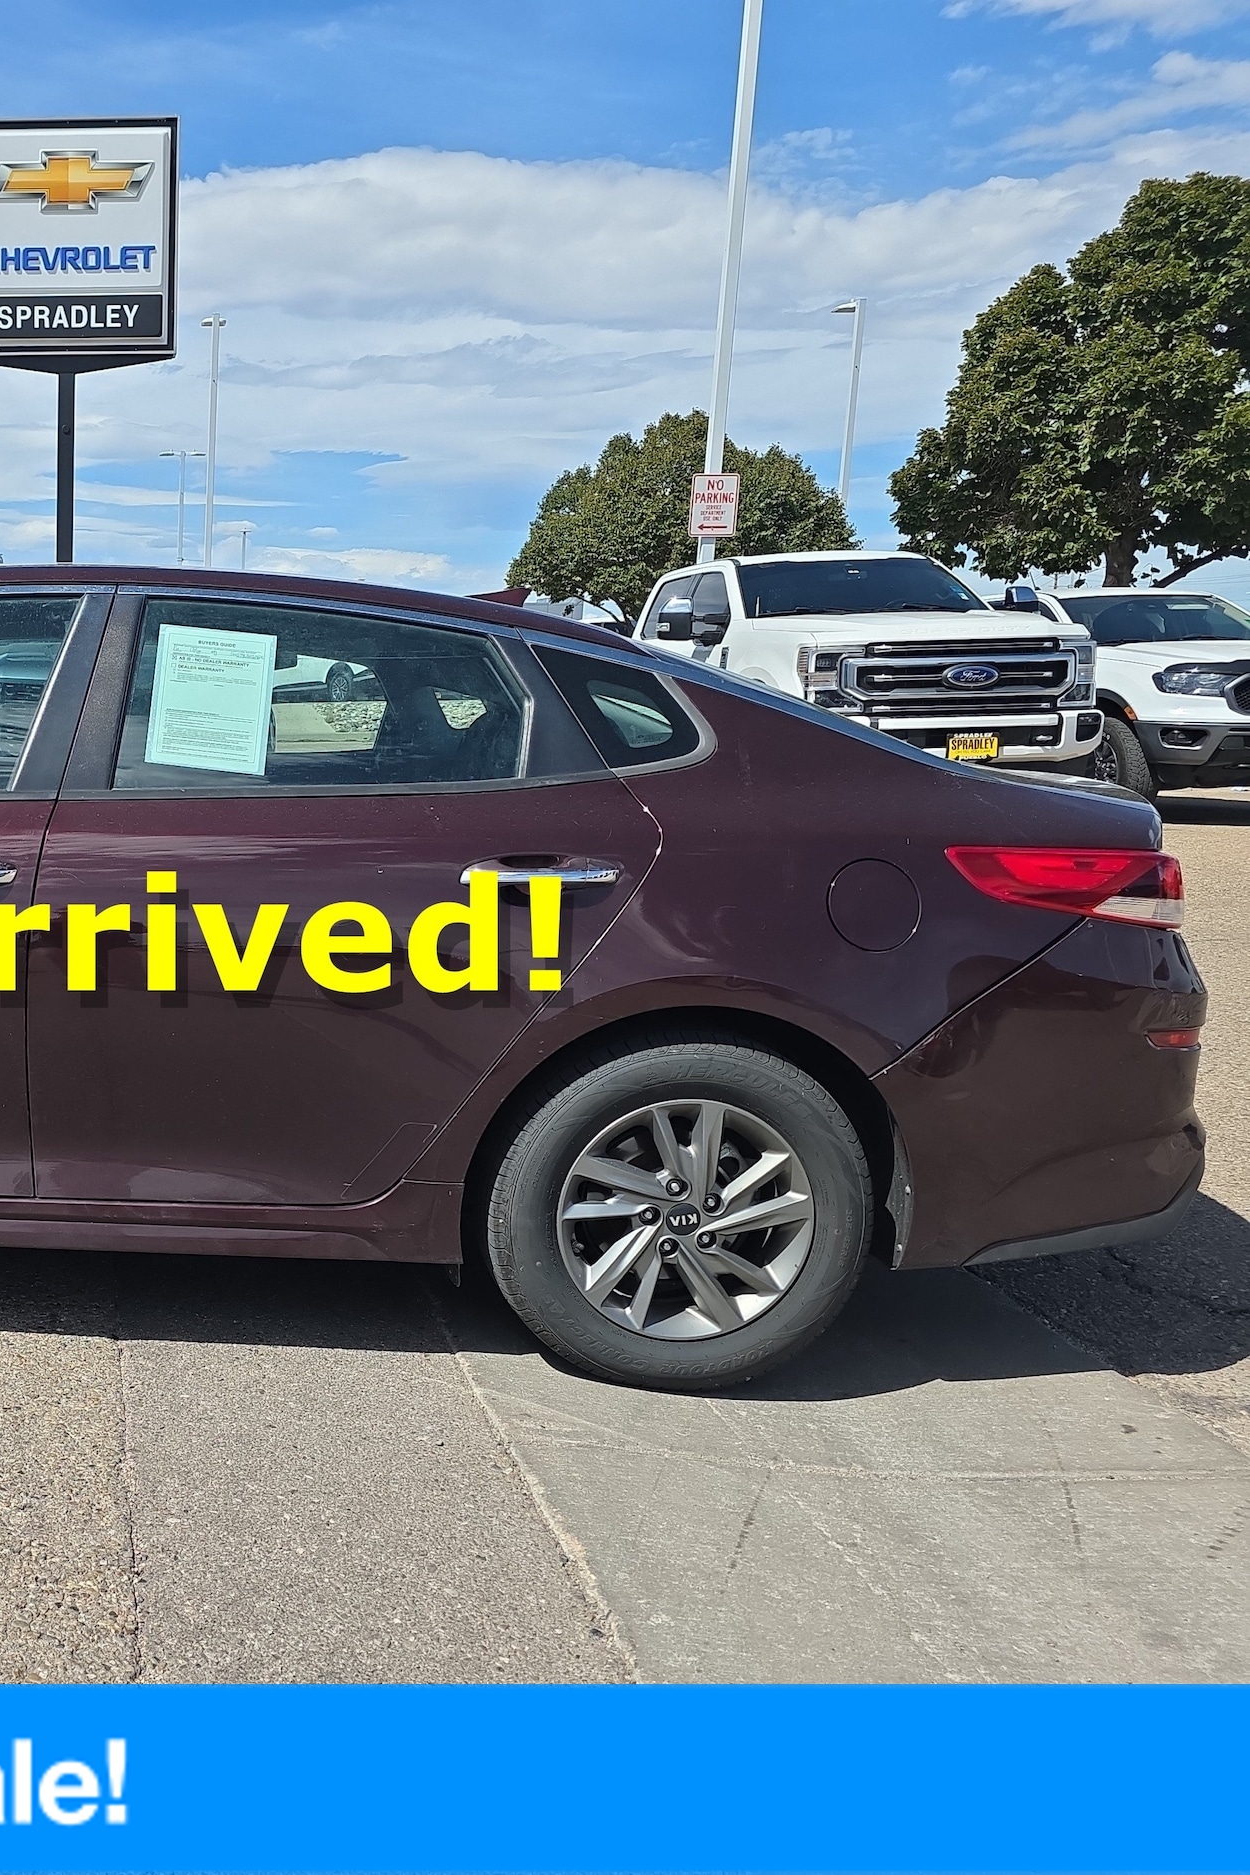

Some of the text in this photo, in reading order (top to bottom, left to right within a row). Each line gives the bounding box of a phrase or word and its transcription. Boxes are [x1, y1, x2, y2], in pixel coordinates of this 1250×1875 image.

[707, 479, 724, 491] NO
[695, 492, 735, 504] PARKING
[960, 670, 988, 682] Ford
[951, 738, 995, 751] SPRADLEY
[669, 1213, 698, 1227] KIA
